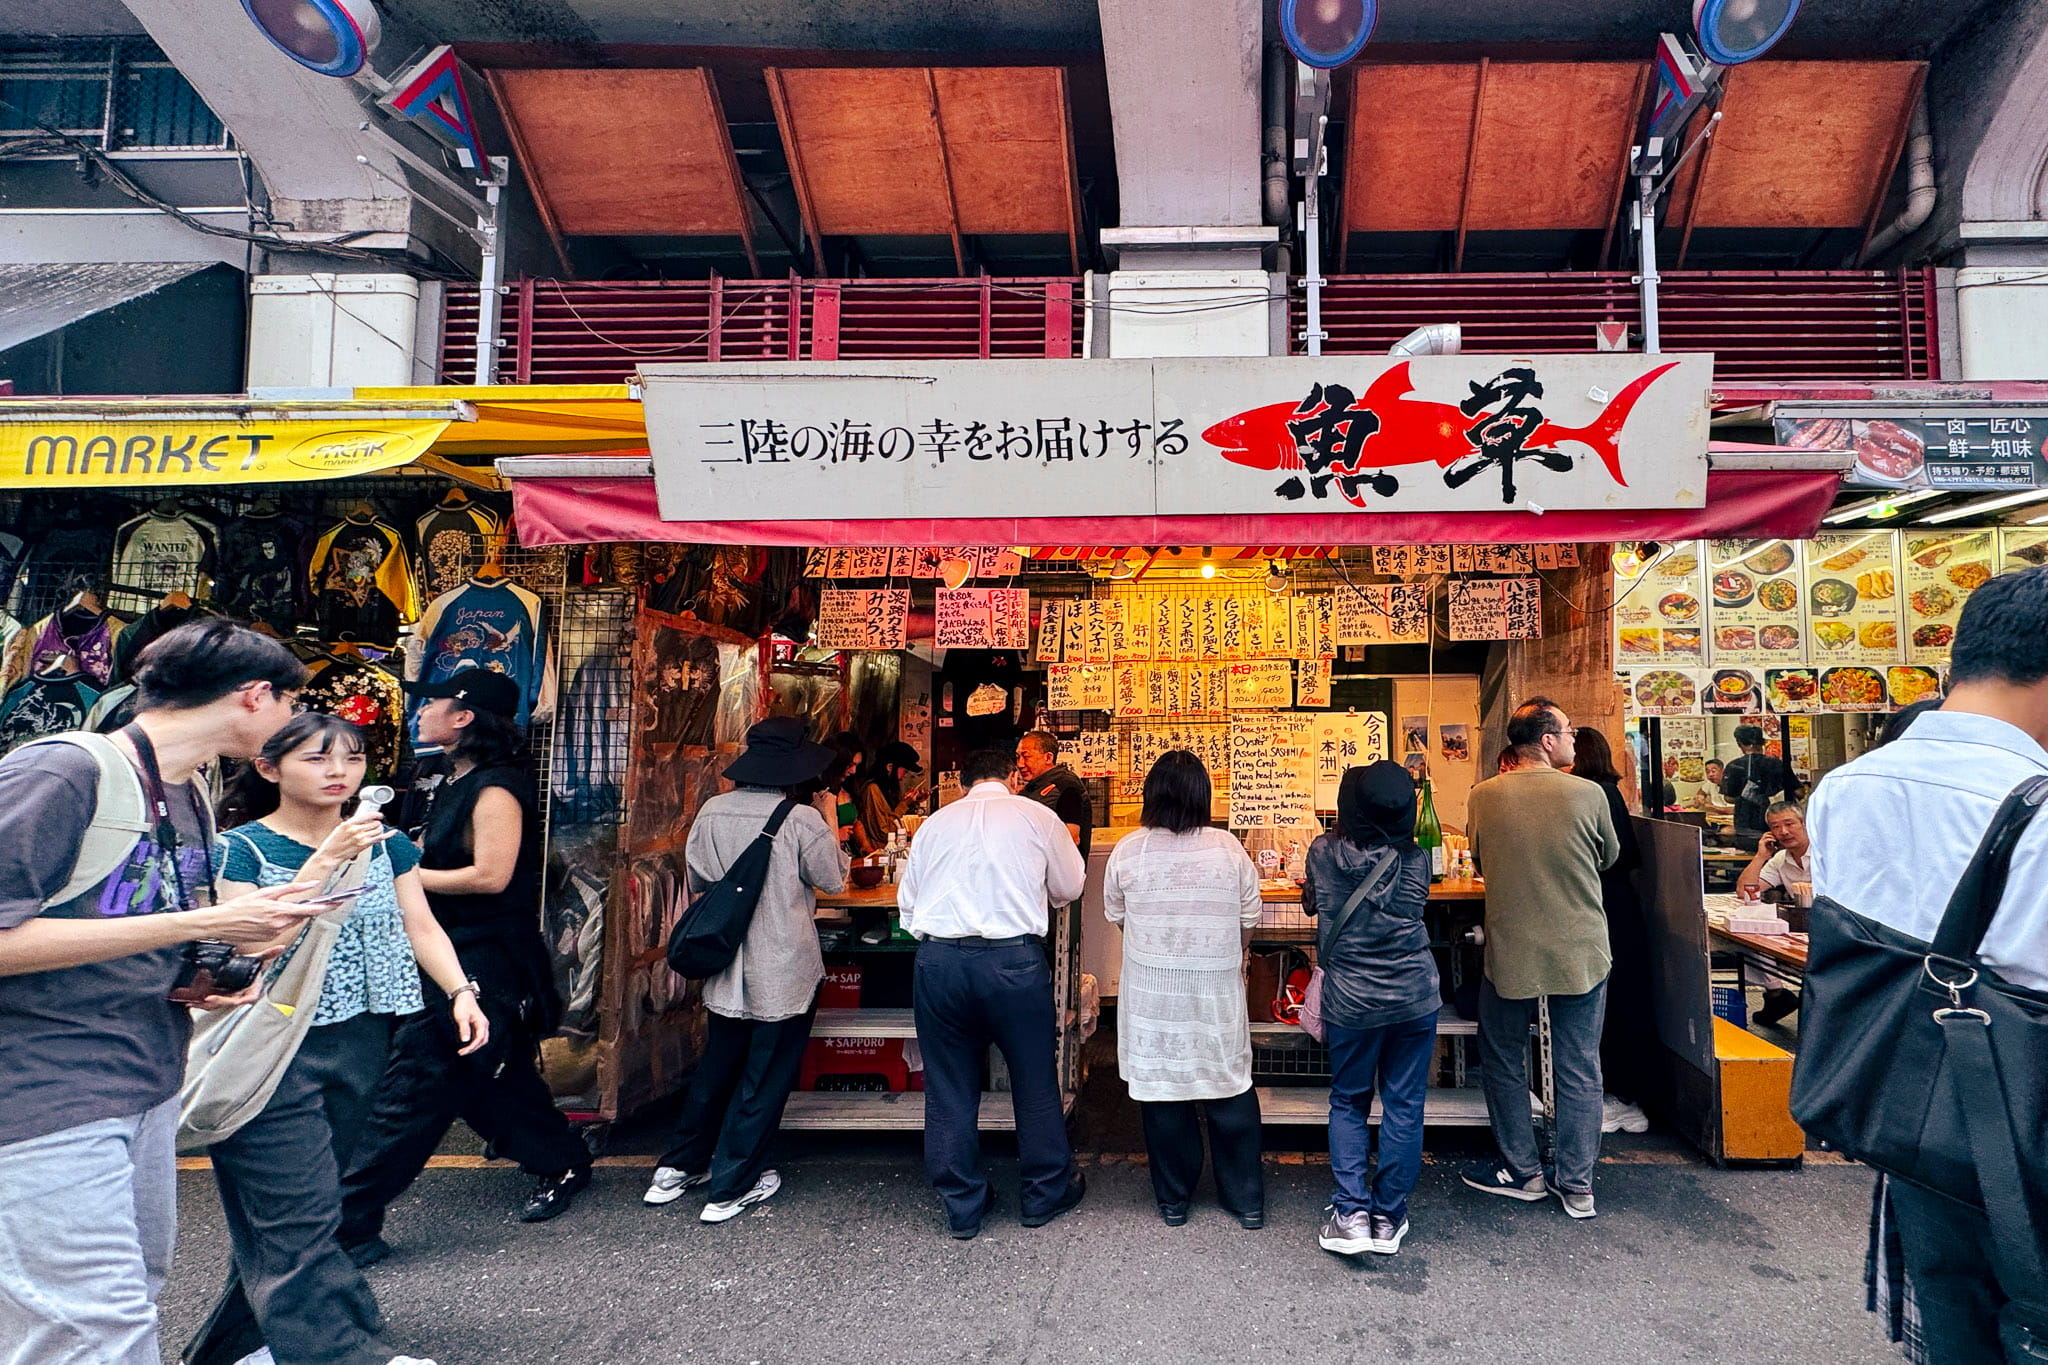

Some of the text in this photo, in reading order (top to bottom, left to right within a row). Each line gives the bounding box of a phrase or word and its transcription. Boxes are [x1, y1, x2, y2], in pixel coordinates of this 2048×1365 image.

[25, 434, 274, 475] MARKET
[699, 417, 1189, 465] 三陸の海の幸をお届けする
[142, 542, 188, 553] WANTED
[455, 607, 506, 625] Japan
[1067, 602, 1084, 640] ほや
[1088, 600, 1107, 647] 生穴子
[1179, 599, 1195, 648] くじら赤肉
[1201, 599, 1219, 655] まぐろ脳天
[1223, 597, 1241, 648] たらばがに
[1190, 670, 1203, 711] いくら丼
[1301, 661, 1319, 695] 刺盛り
[1119, 706, 1144, 716] 1000
[1300, 695, 1325, 705] 1000
[1081, 734, 1094, 764] 白老
[1270, 746, 1299, 757] SASHIMI
[1232, 770, 1254, 780] Tuna
[1255, 769, 1273, 780] head
[1233, 759, 1255, 772] King
[1255, 759, 1278, 768] Crab
[1234, 812, 1301, 825] SAKE Beer
[836, 1037, 885, 1048] SAPPORO
